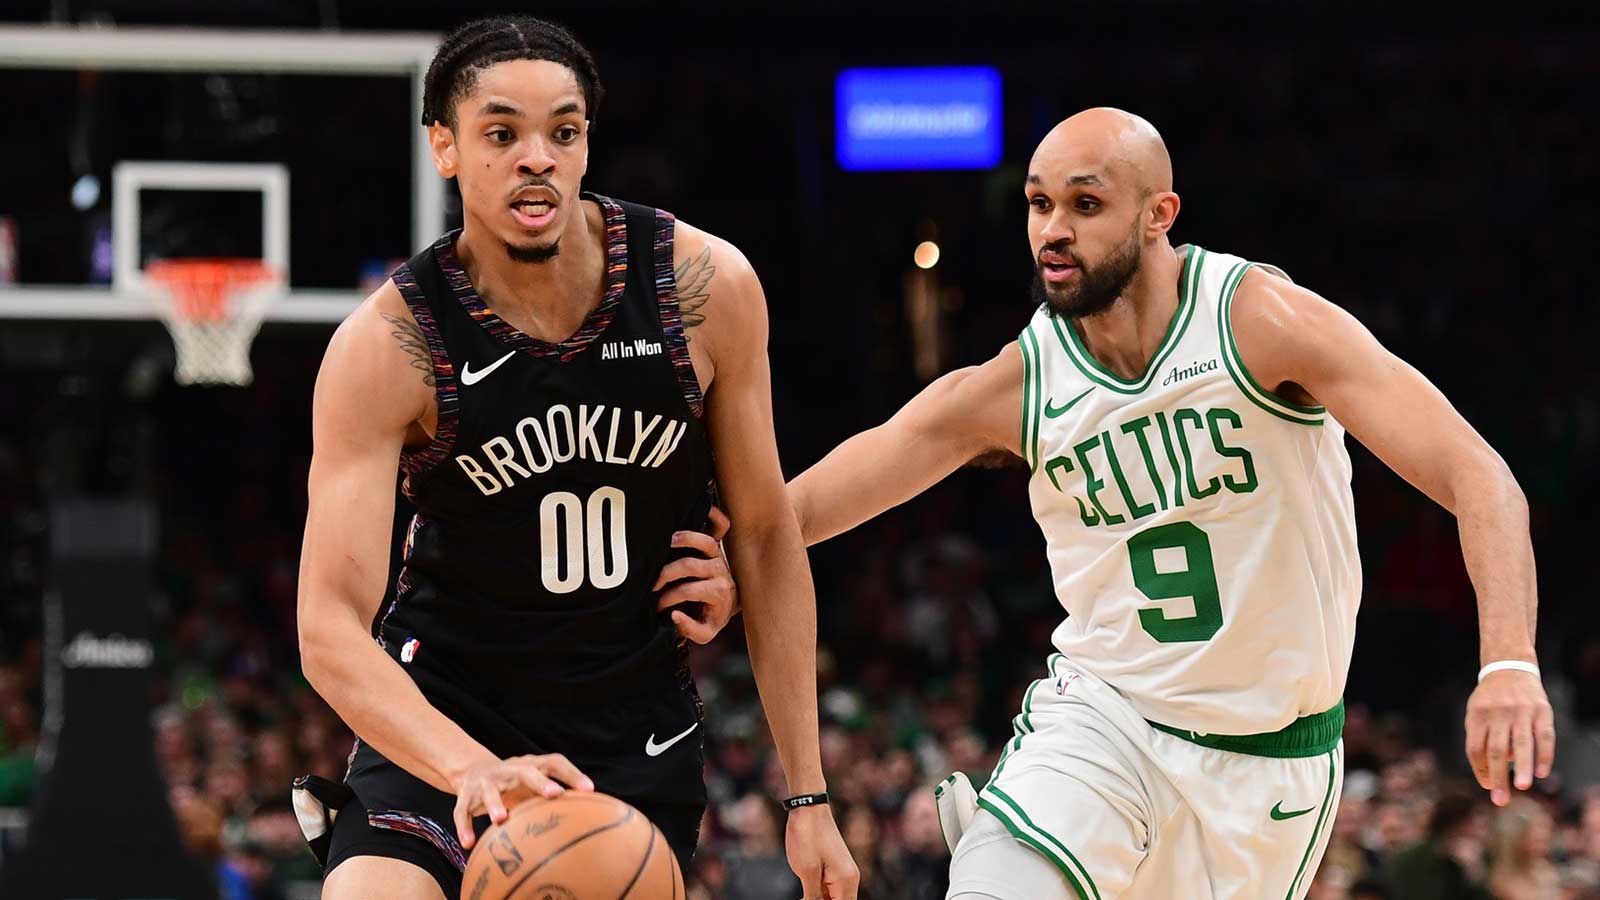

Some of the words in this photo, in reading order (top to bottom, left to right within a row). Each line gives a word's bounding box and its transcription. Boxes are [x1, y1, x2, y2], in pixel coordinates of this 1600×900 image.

[601, 343, 618, 360] All
[620, 341, 633, 358] In
[634, 339, 662, 357] Won
[1163, 359, 1218, 386] Amica
[455, 404, 687, 496] BROOKLYN
[1044, 408, 1258, 527] CELTICS
[540, 486, 629, 593] 00
[1127, 521, 1224, 643] 9
